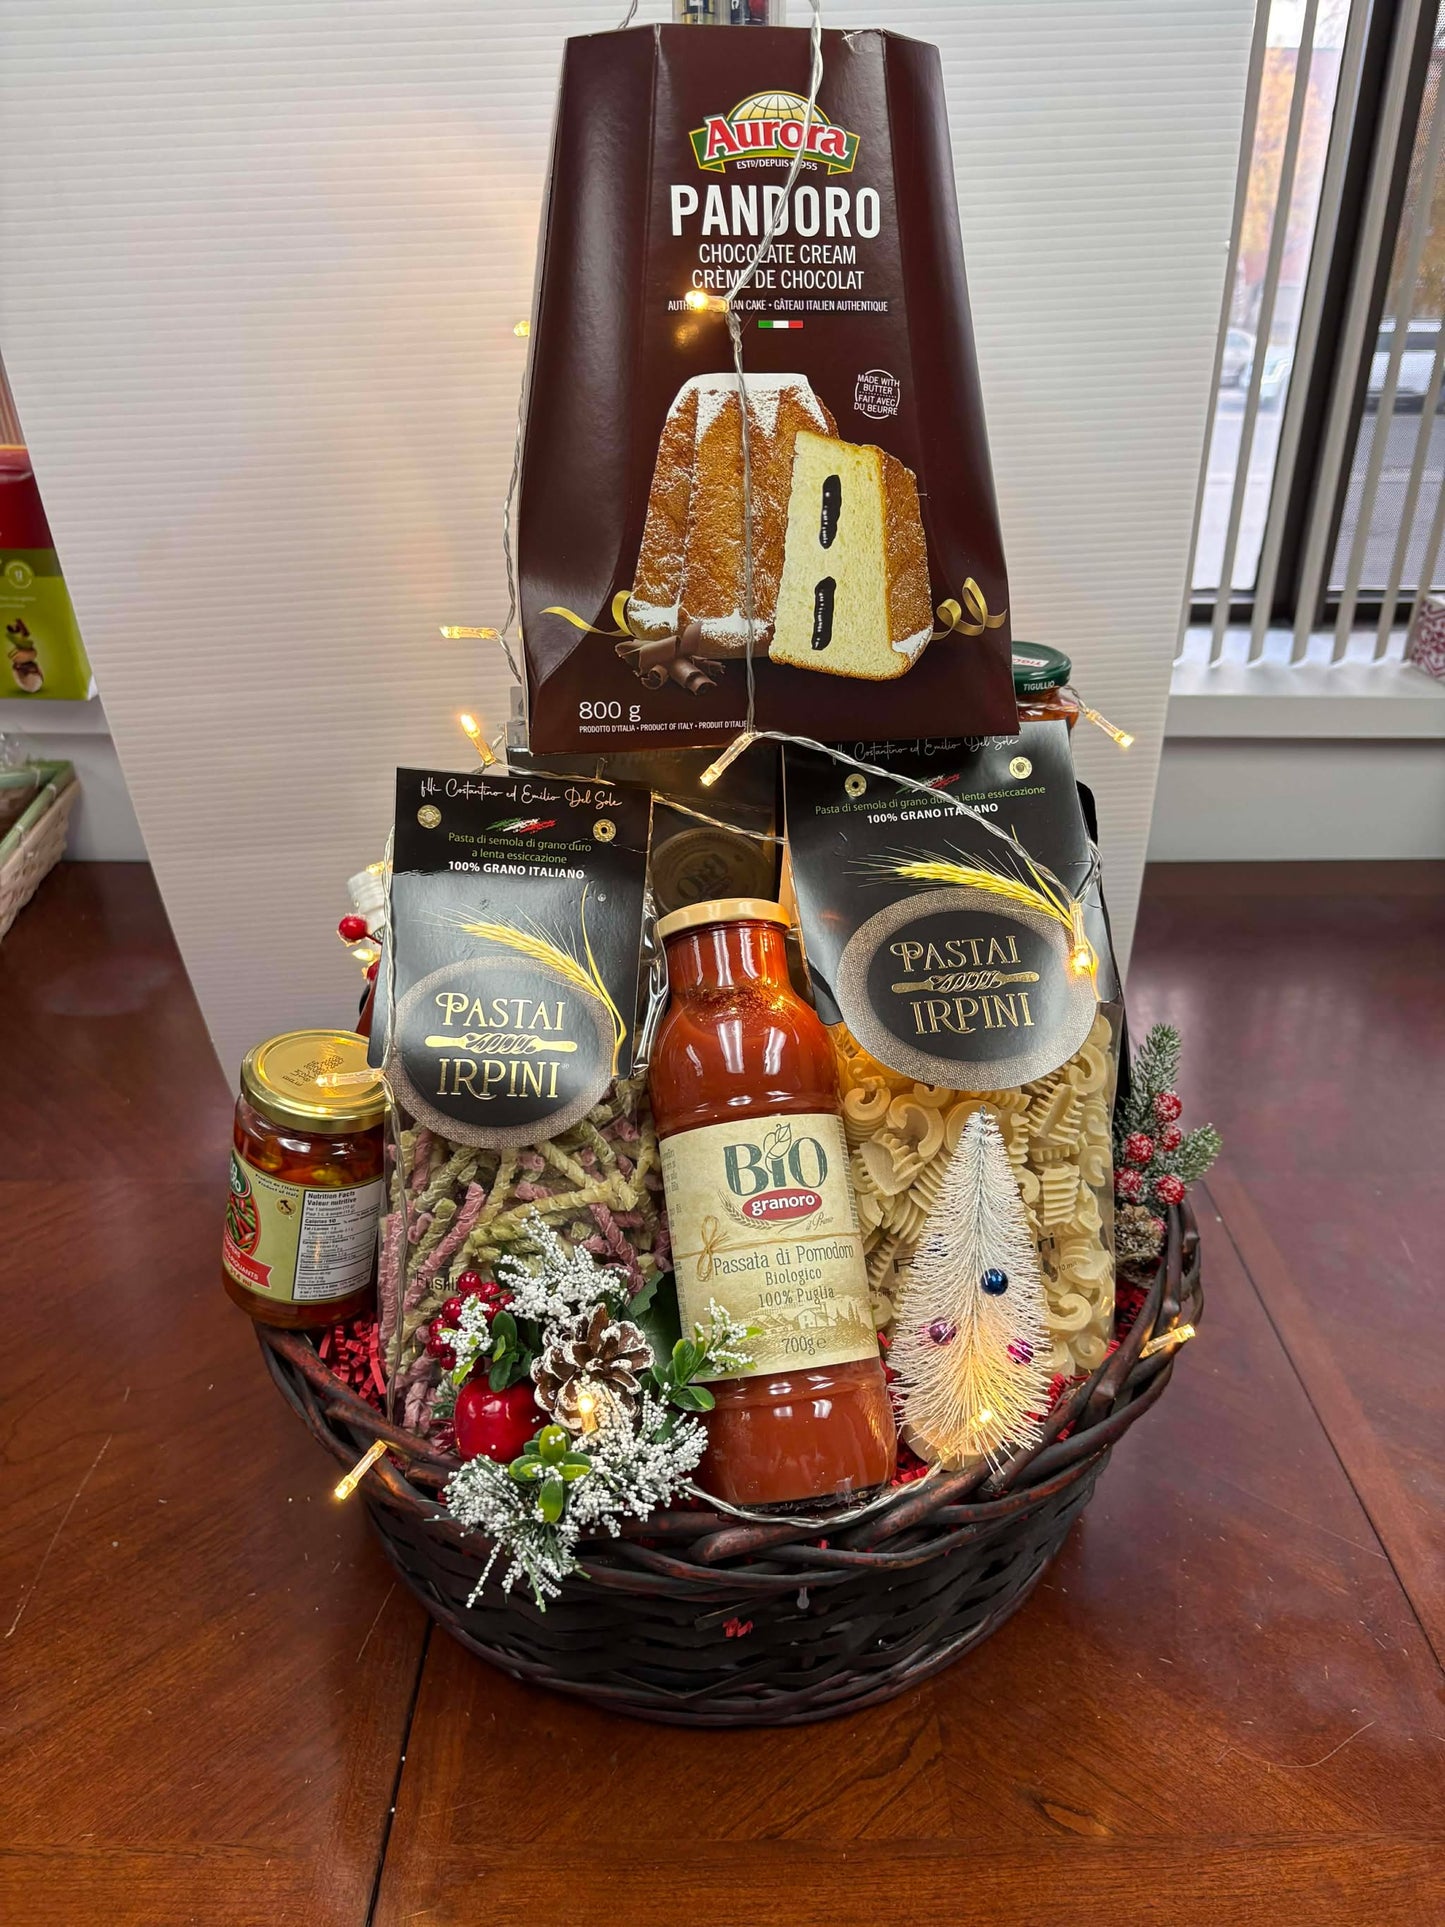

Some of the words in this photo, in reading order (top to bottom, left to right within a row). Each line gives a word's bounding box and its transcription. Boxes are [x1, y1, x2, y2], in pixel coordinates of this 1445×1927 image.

[704, 116, 850, 160] Aurora
[670, 184, 881, 239] PANDORO
[698, 243, 796, 264] CHOCOLATE
[800, 244, 857, 265] CREAM
[755, 270, 777, 289] DE
[780, 270, 865, 290] CHOCOLAT
[745, 300, 767, 311] CAKE
[773, 297, 802, 311] GÂTEAU
[806, 300, 835, 311] ITALIEN
[836, 300, 889, 312] AUTHENTIQUE
[857, 374, 879, 385] MADE
[880, 377, 900, 388] WITH
[862, 383, 893, 395] BUTTER
[853, 402, 865, 411] DU
[867, 403, 898, 416] BEURRE
[858, 394, 875, 403] FAIT
[876, 396, 896, 407] AVEC
[1023, 680, 1055, 691] TIGULLIO
[578, 701, 622, 720] 800
[628, 703, 642, 723] g
[579, 725, 610, 733] PRODOTTO
[611, 724, 636, 733] D'ITALIA
[640, 723, 668, 732] PRODUCT
[669, 722, 677, 731] OF
[677, 721, 695, 731] ITALY
[698, 720, 724, 729] PRODUIT
[924, 738, 960, 756] Emilio
[445, 778, 503, 801] Costantino
[505, 787, 517, 802] ed
[521, 784, 561, 804] Emilio
[564, 788, 592, 807] Del
[594, 790, 623, 810] Sole
[815, 803, 840, 815] Pasta
[841, 802, 851, 813] di
[852, 798, 887, 811] semola
[888, 797, 899, 809] di
[900, 796, 928, 810] grano
[961, 791, 986, 801] lenta
[987, 785, 1046, 799] essiccazione
[866, 813, 898, 824] 100%
[900, 808, 942, 821] GRANO
[944, 802, 999, 817] ITAANO
[448, 832, 475, 844] Pasta
[476, 833, 487, 845] di
[488, 835, 524, 847] semola
[525, 836, 536, 848] di
[537, 839, 567, 852] grano
[568, 839, 592, 852] duro
[471, 851, 478, 859] a
[480, 849, 505, 860] lenta
[506, 850, 568, 864] essiccazione
[448, 860, 480, 872] 100%
[483, 863, 526, 876] GRANO
[529, 866, 585, 880] ITALIANO
[889, 935, 1022, 973] PASTAI
[435, 992, 566, 1031] PASTAI
[910, 992, 1035, 1035] IRPINI
[436, 1058, 561, 1100] IRPINI
[751, 1194, 816, 1217] granoro
[713, 1251, 770, 1276] Passata
[776, 1247, 791, 1266] di
[765, 1268, 822, 1286] Biologico
[758, 1289, 793, 1308] 100%
[796, 1285, 835, 1305] Puglia
[781, 1336, 816, 1356] 700g
